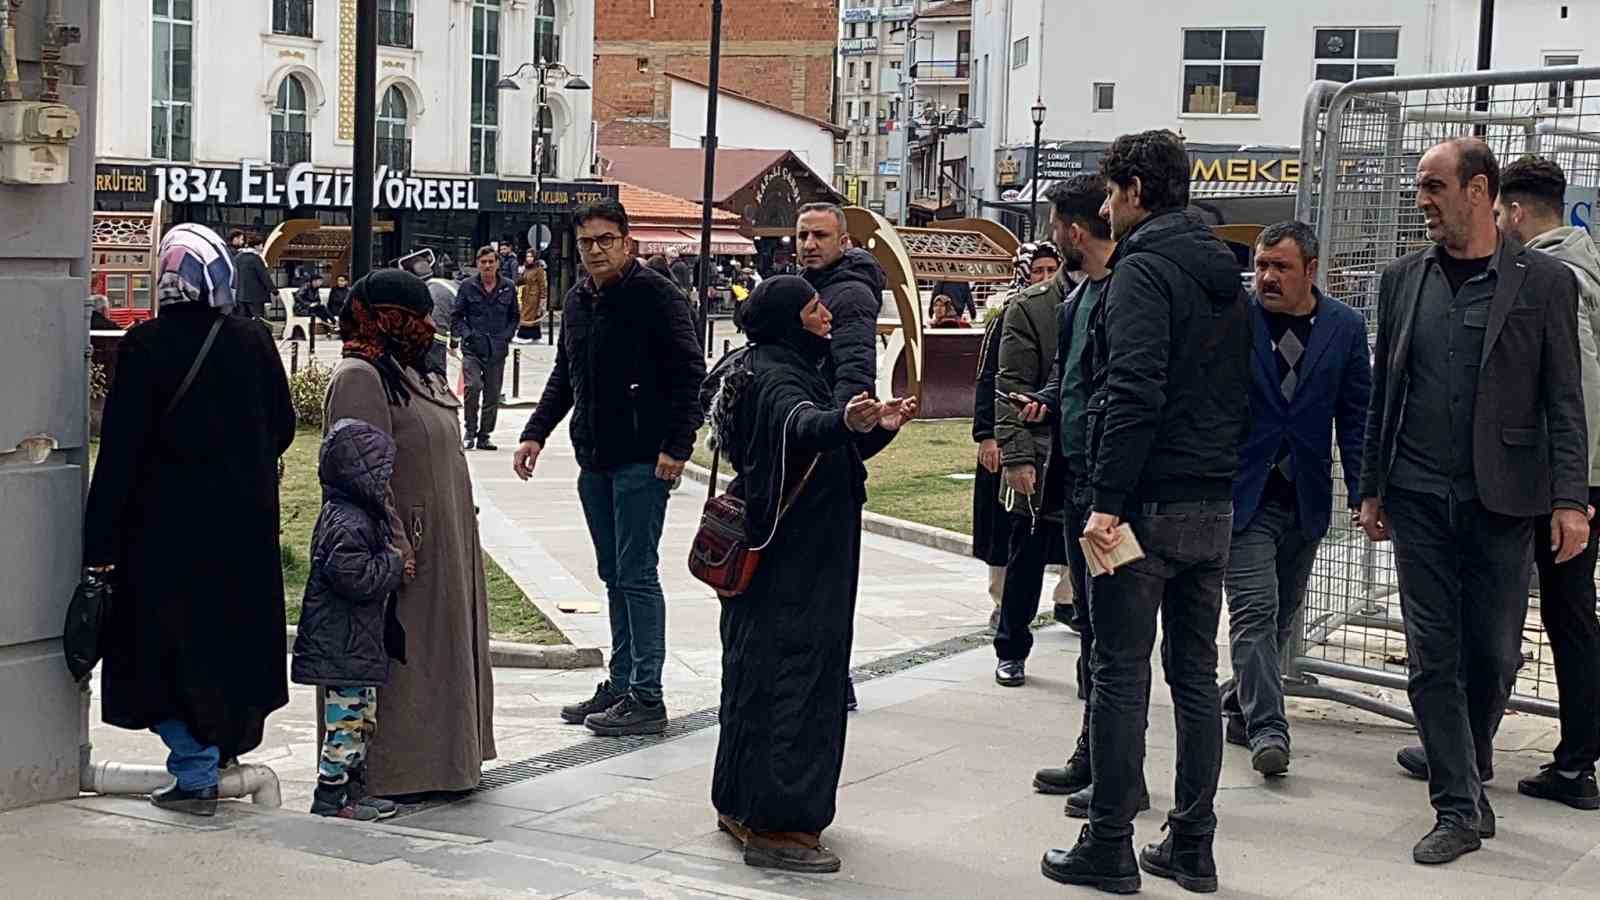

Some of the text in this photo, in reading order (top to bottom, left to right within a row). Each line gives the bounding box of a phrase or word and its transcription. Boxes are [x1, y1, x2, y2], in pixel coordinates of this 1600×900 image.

[1047, 152, 1071, 160] LOKUM
[96, 167, 147, 193] RKÜTERİ
[1192, 158, 1301, 182] MEKE
[153, 167, 228, 204] 1834
[373, 164, 480, 212] YÖRESEL
[496, 189, 526, 203] LOKUM
